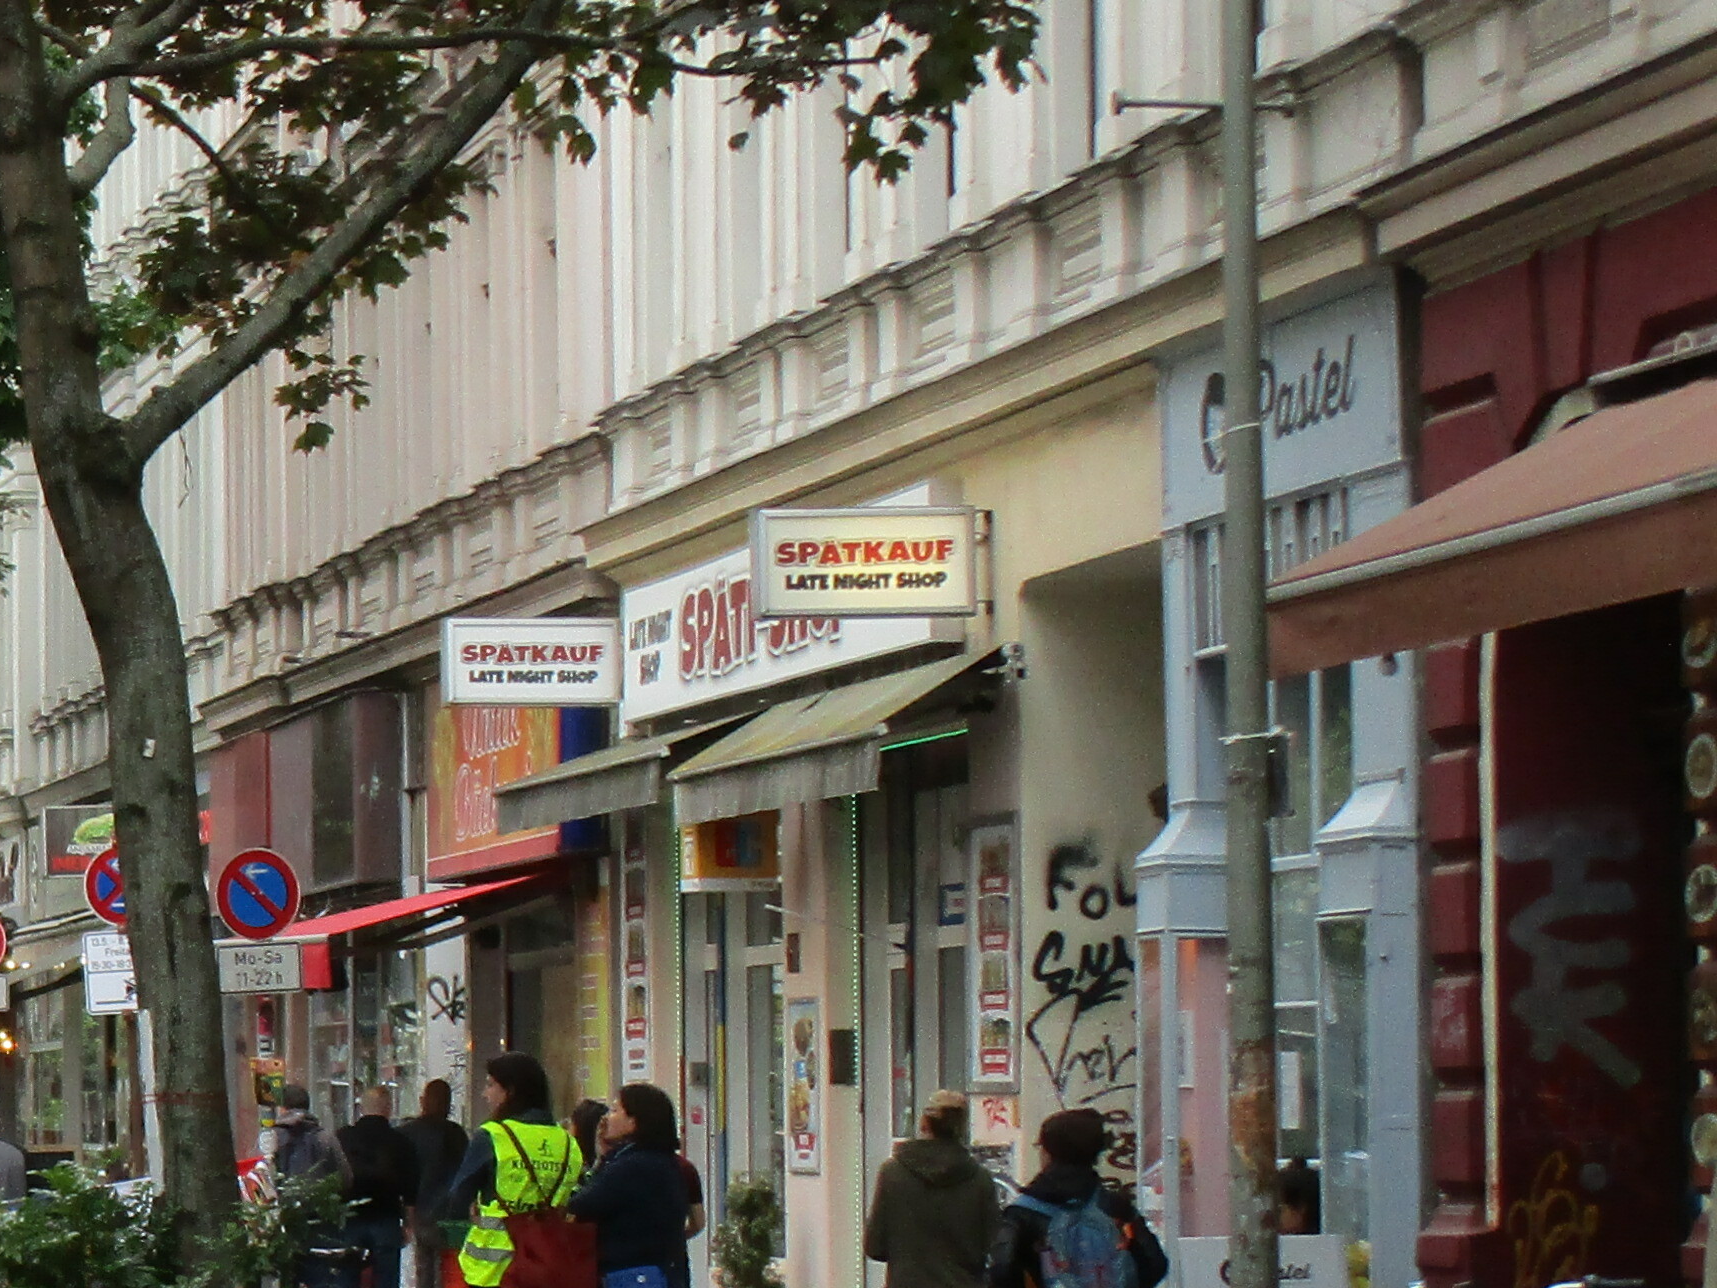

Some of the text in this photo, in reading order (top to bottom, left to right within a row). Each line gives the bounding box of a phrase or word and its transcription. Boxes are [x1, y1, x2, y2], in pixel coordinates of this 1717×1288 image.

[776, 539, 954, 565] SPÄTKAUF
[785, 571, 947, 590] LATE NIGHT SHOP
[462, 643, 603, 664] SPÄTKAUF
[469, 670, 598, 684] LATE NIGHT SHOP
